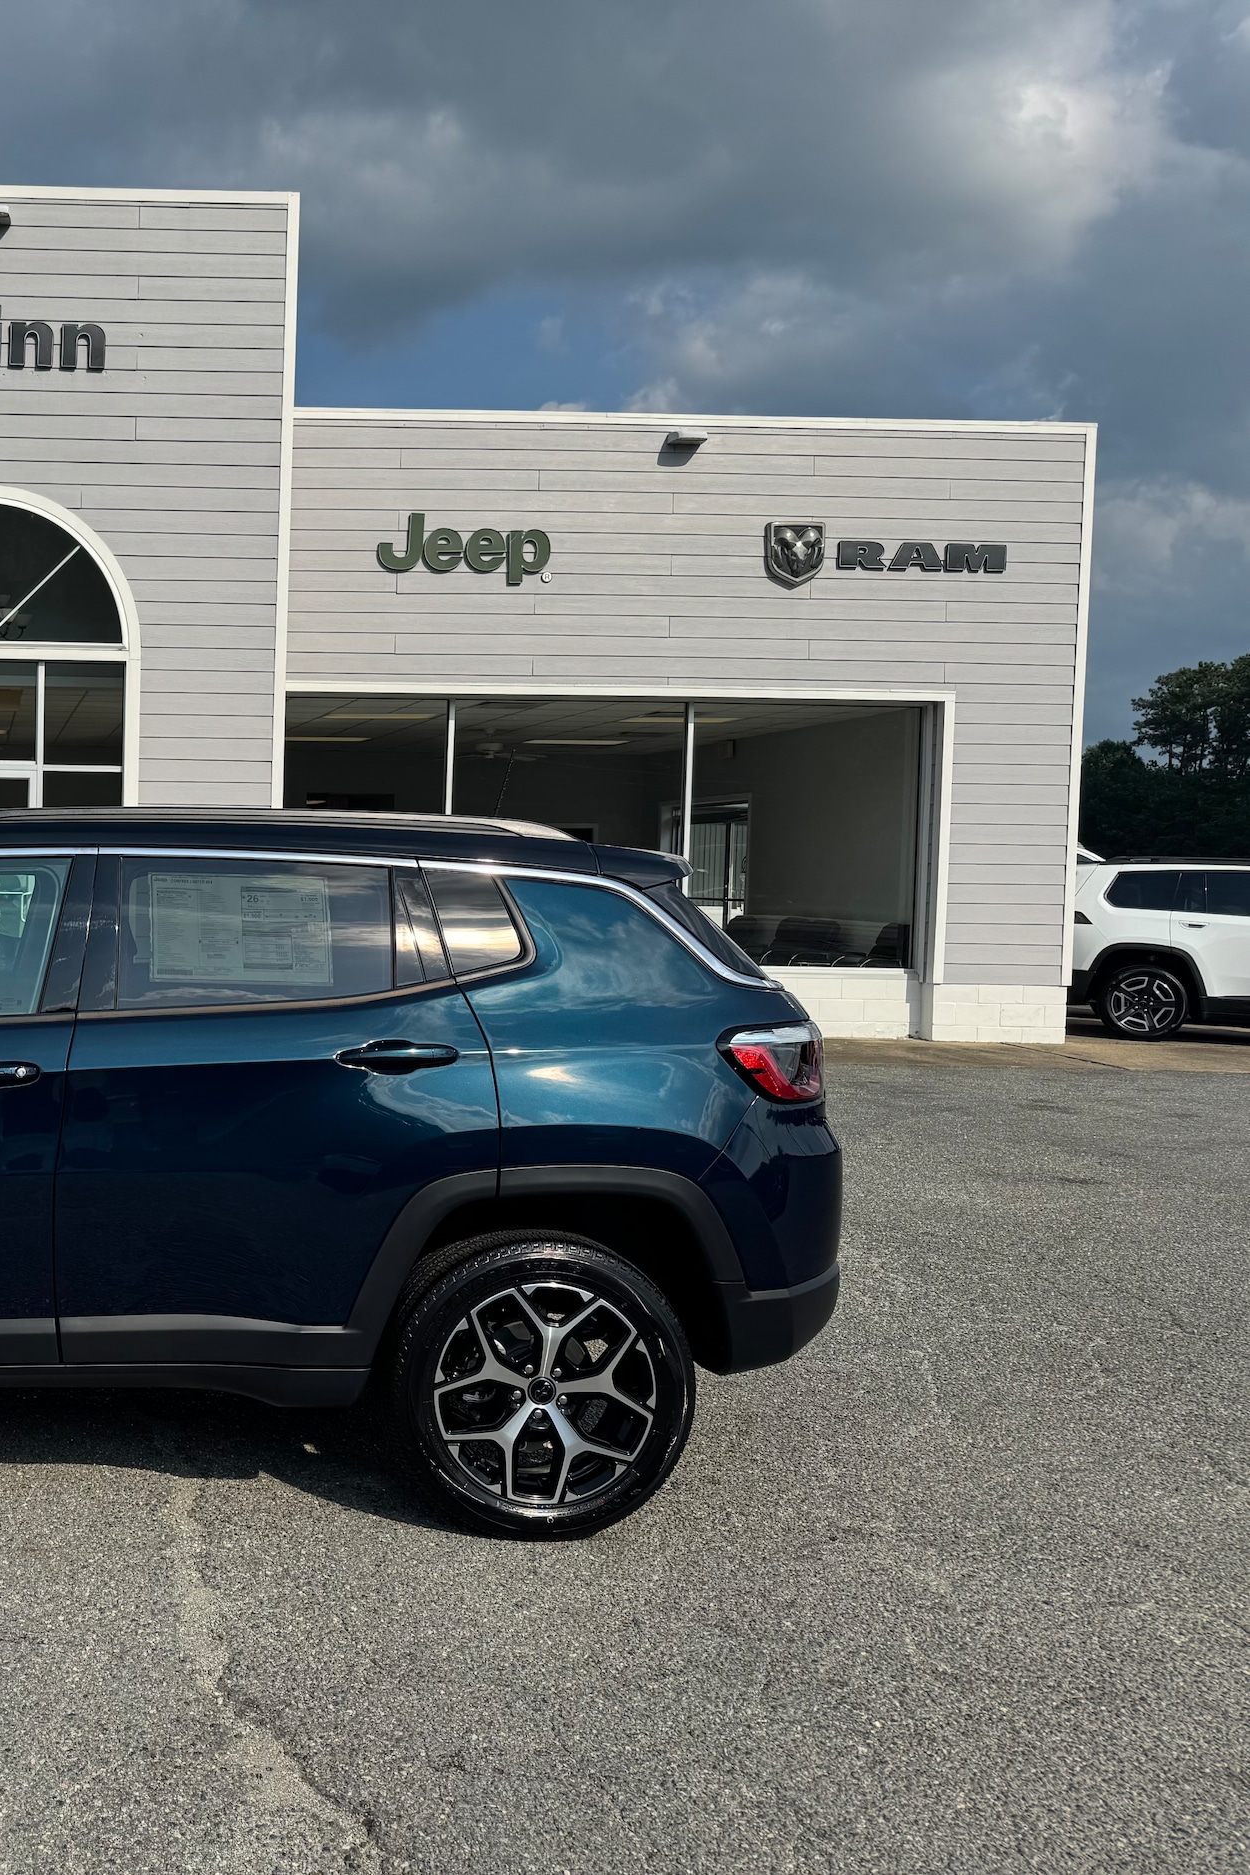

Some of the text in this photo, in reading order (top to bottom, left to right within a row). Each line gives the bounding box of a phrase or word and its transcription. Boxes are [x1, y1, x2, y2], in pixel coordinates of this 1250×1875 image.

[376, 512, 551, 587] Jeep
[836, 540, 1007, 573] RAM
[246, 894, 259, 903] 26
